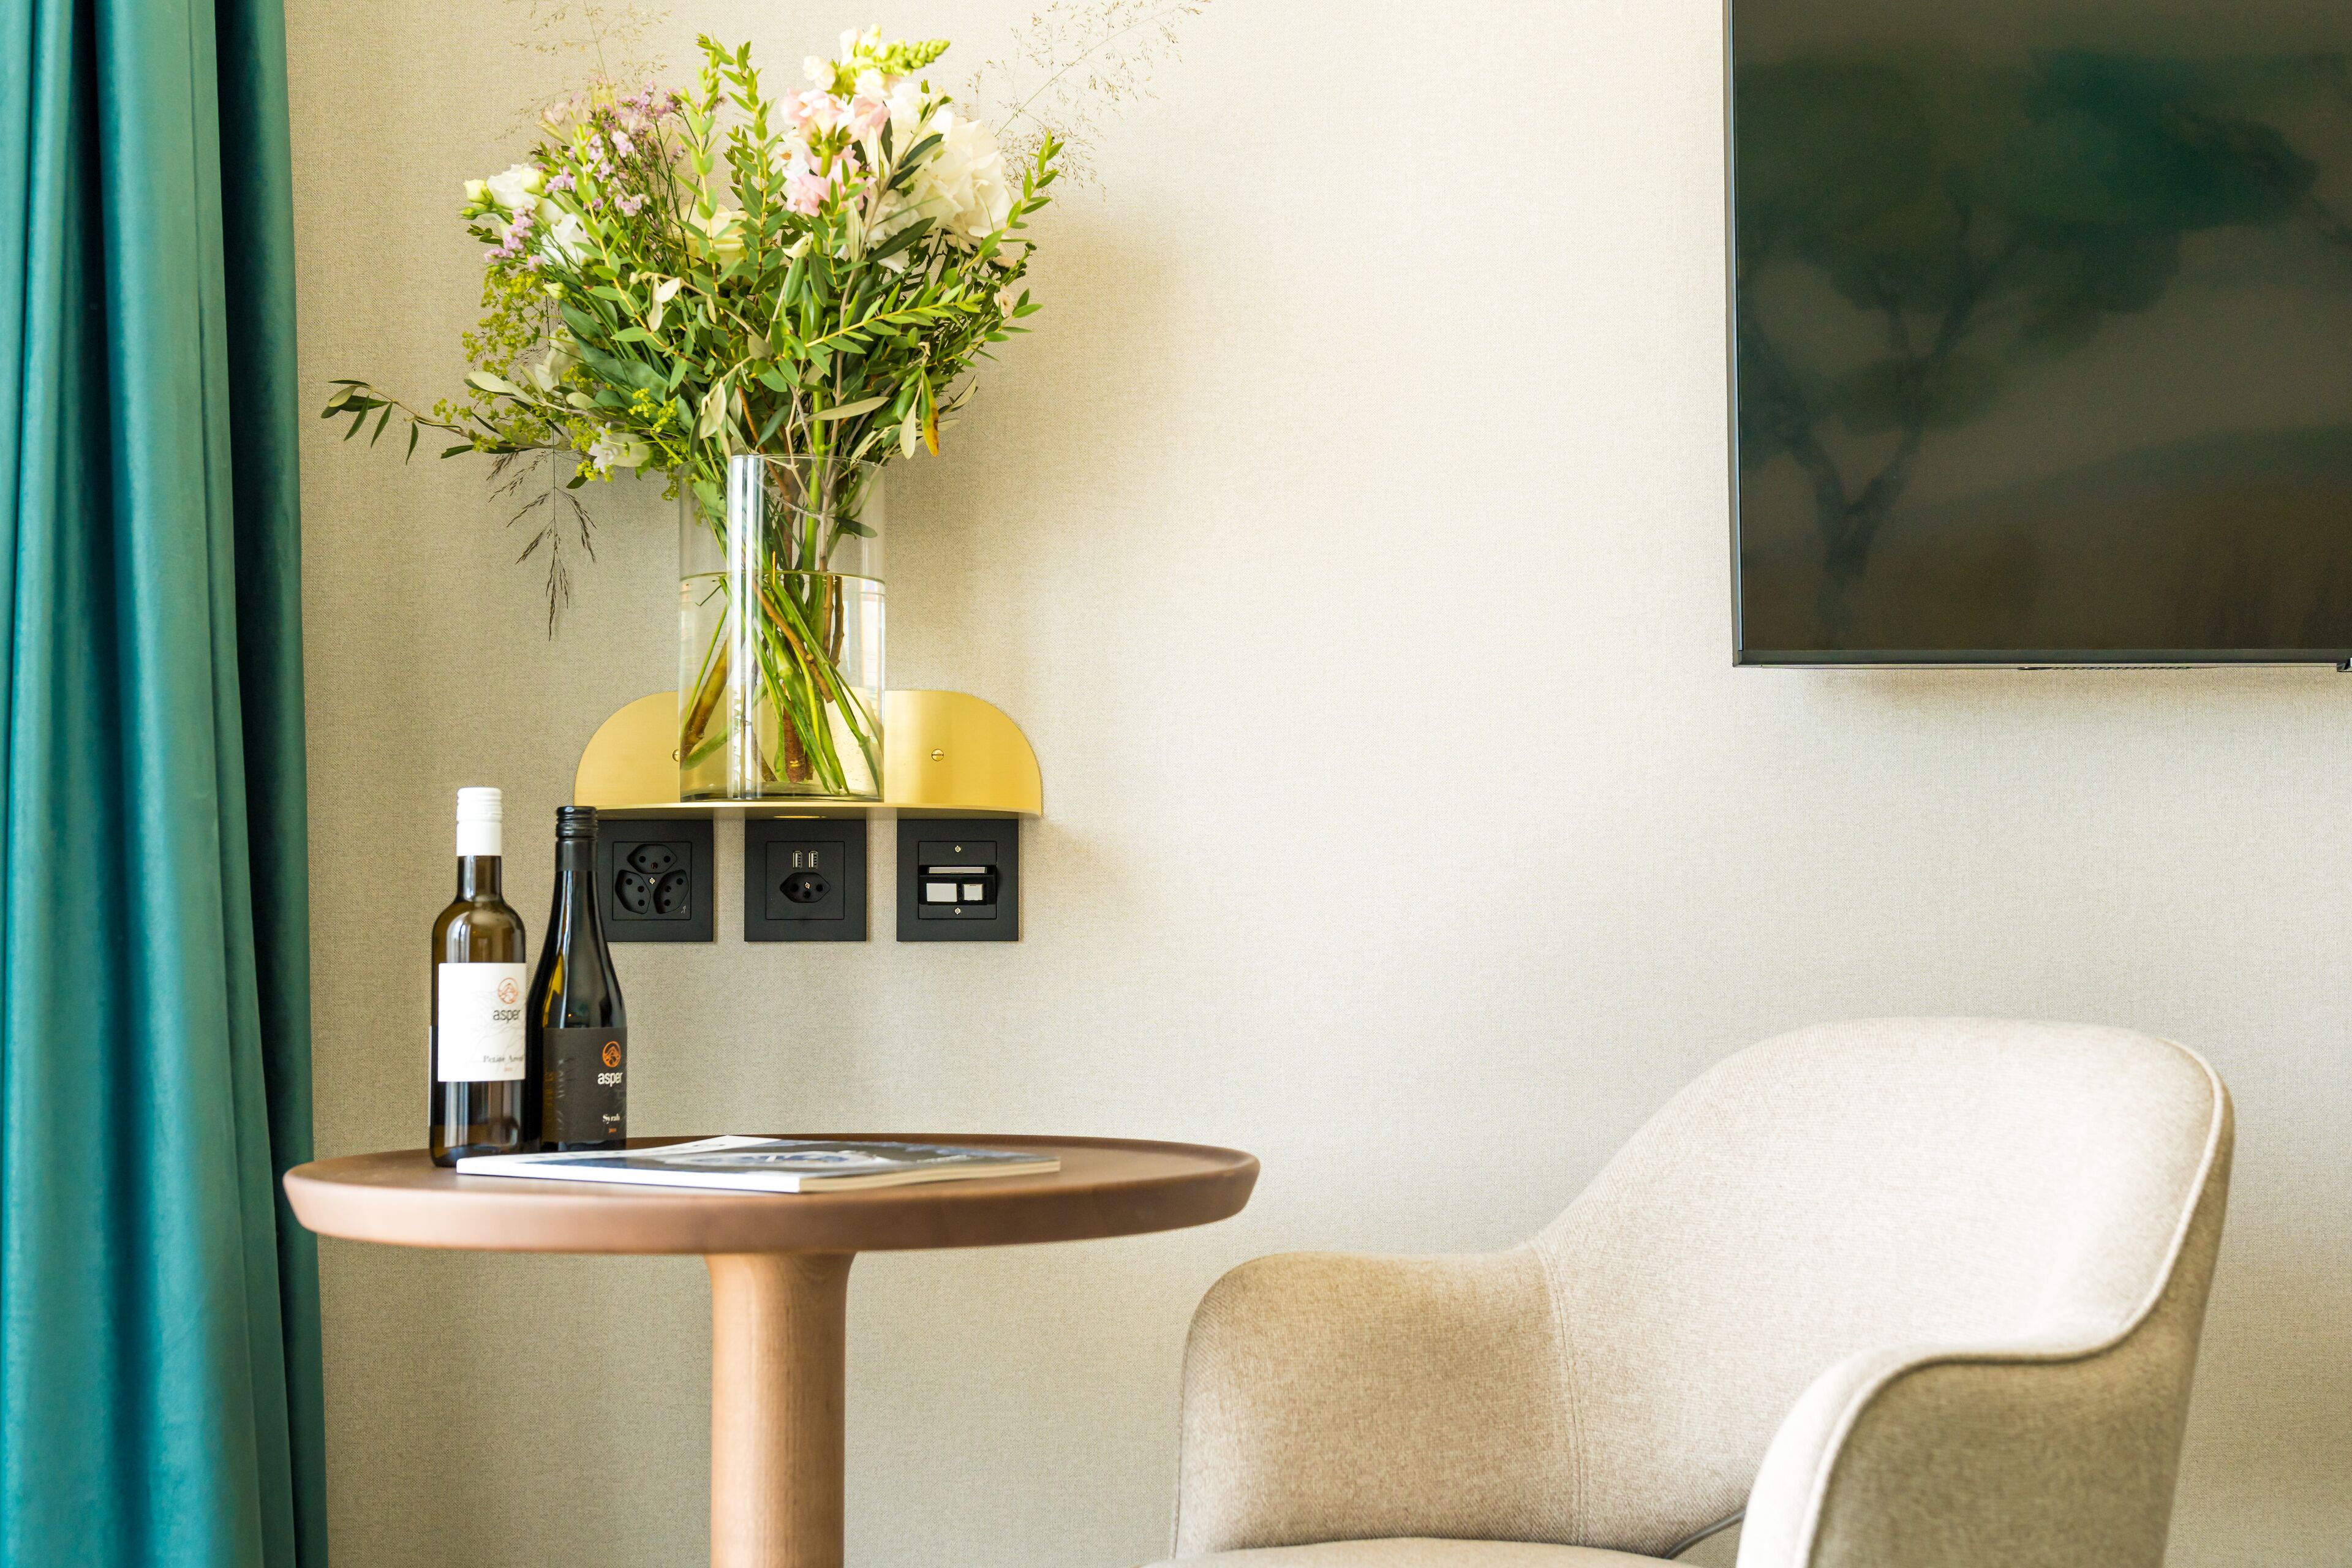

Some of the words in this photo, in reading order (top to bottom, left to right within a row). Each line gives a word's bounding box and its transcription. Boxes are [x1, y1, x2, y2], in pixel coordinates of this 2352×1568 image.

[492, 1009, 521, 1023] asper
[597, 1072, 623, 1087] asper
[602, 1113, 620, 1125] Syrah
